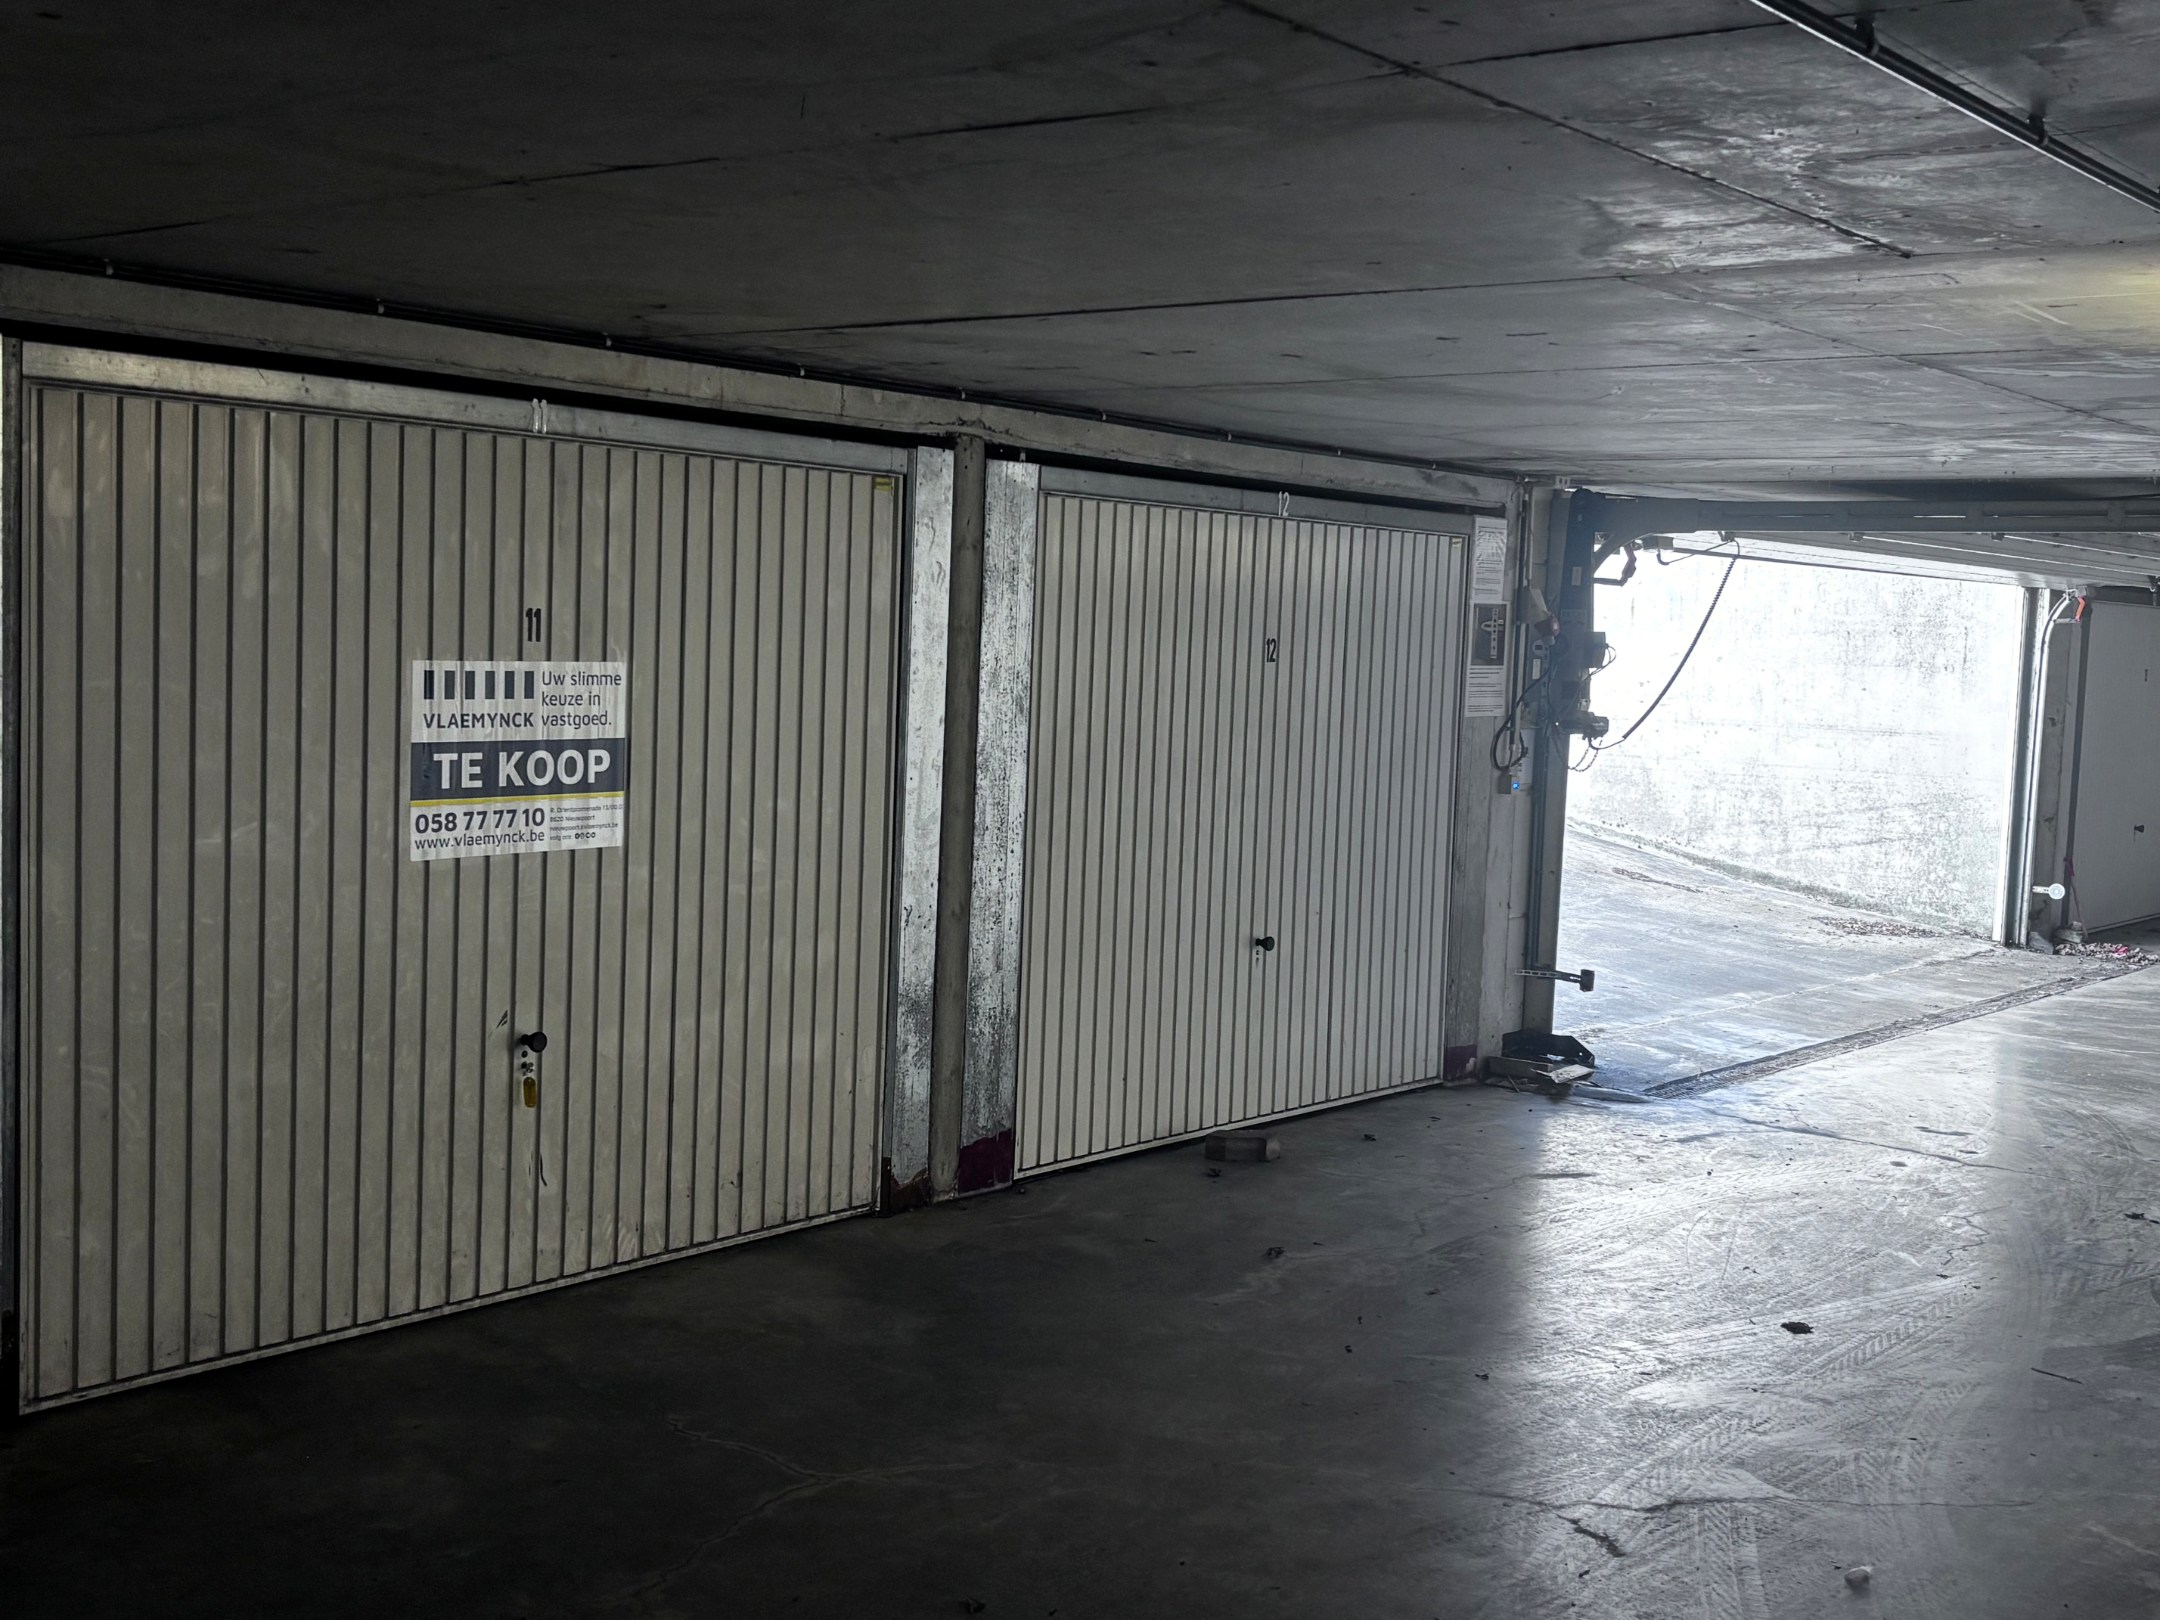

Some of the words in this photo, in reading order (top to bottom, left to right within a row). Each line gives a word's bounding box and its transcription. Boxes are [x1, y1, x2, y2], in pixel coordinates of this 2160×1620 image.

[1278, 490, 1290, 516] 12
[526, 608, 541, 642] 11
[1266, 638, 1277, 663] 12
[542, 671, 565, 686] Uw
[571, 671, 621, 686] slimme
[542, 691, 583, 706] keuze
[589, 691, 601, 706] in
[423, 713, 534, 729] VLAEMYNCK
[541, 710, 611, 729] vastgoed.
[433, 752, 483, 789] TE
[498, 749, 611, 787] KOOP
[415, 812, 457, 834] 058
[463, 811, 488, 830] 77
[493, 809, 517, 829] 77
[522, 807, 545, 827] 10
[414, 829, 545, 850] www.vlaemynck.be
